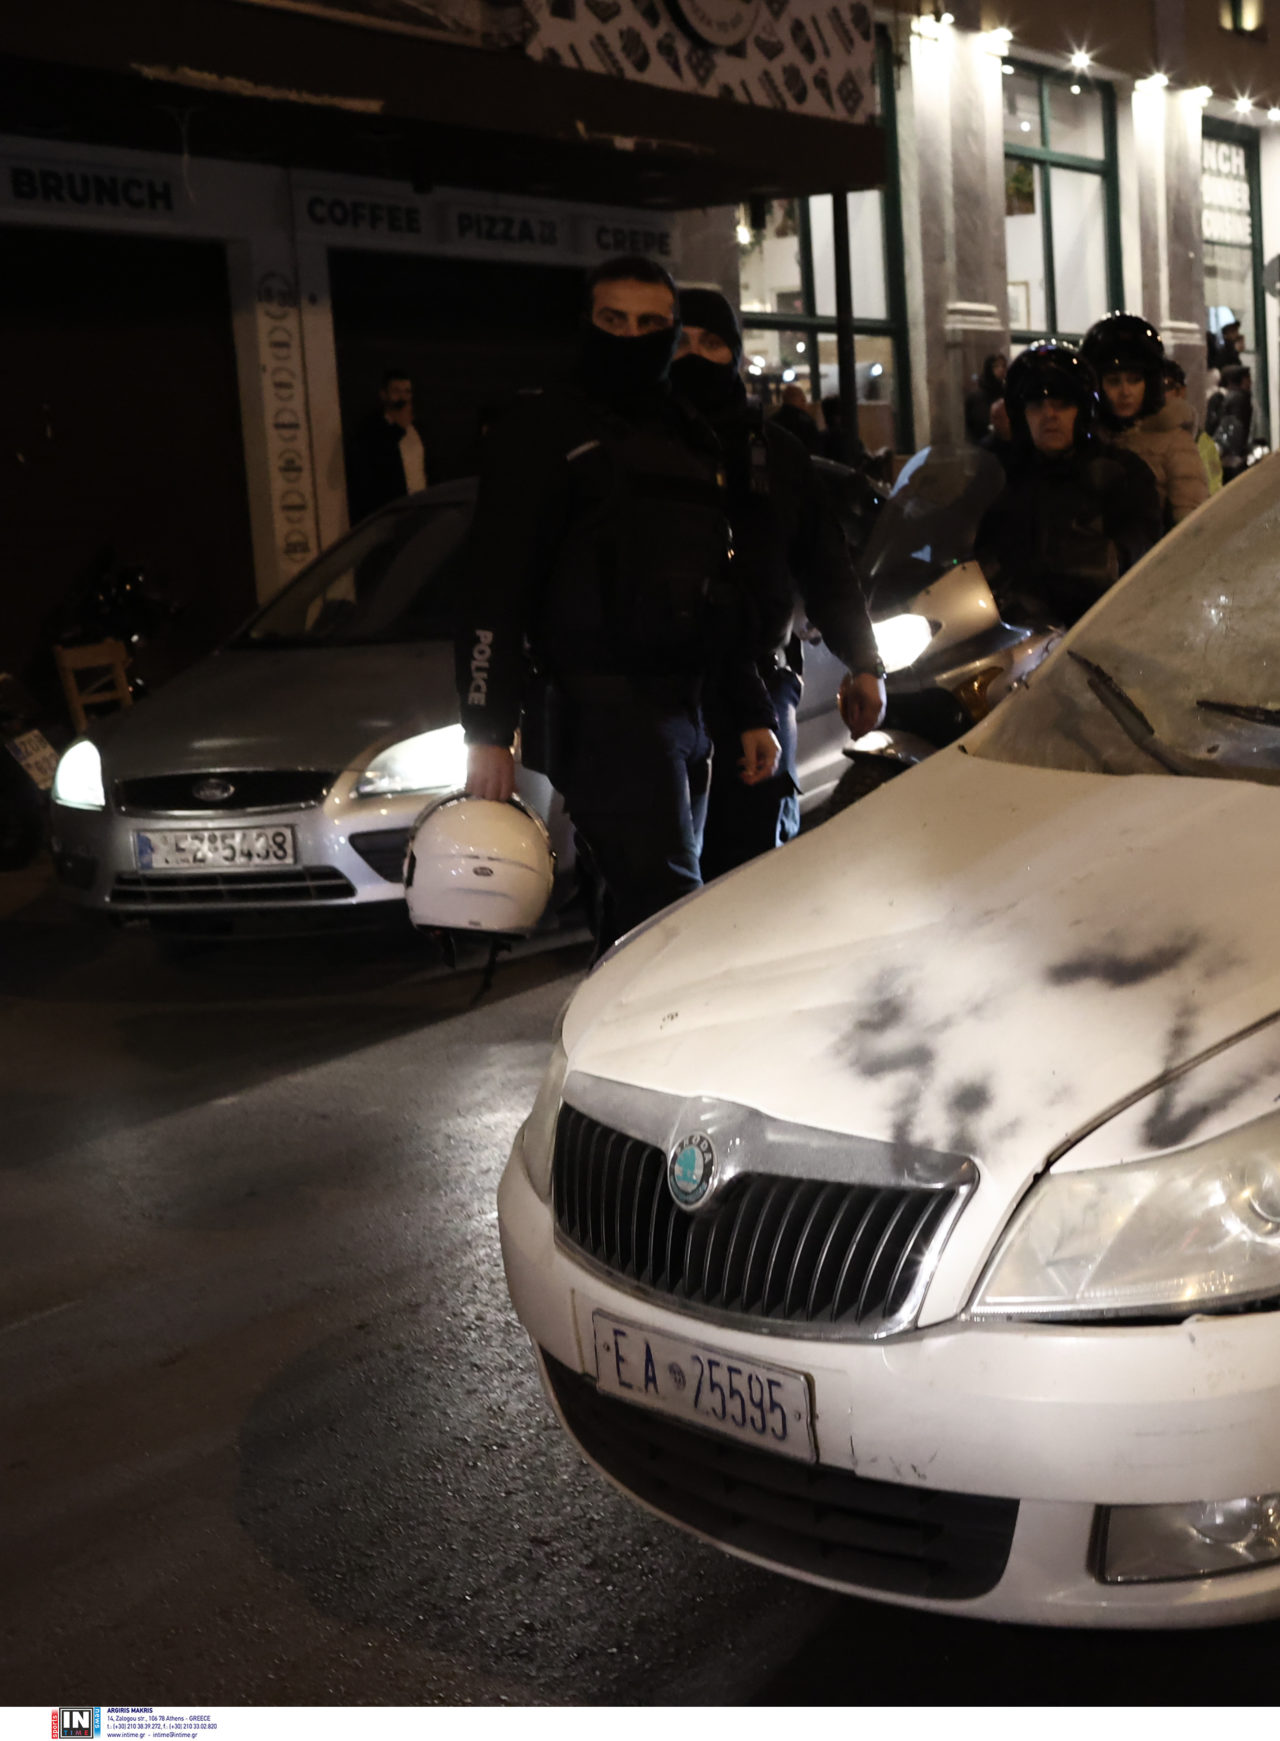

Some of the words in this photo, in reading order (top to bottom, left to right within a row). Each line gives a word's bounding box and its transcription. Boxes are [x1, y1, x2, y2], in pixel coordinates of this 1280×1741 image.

[11, 167, 174, 210] BRUNCH
[308, 197, 421, 234] COFFEE
[457, 211, 536, 244] PIZZA
[595, 225, 671, 256] CREPE
[468, 630, 494, 706] POLICE
